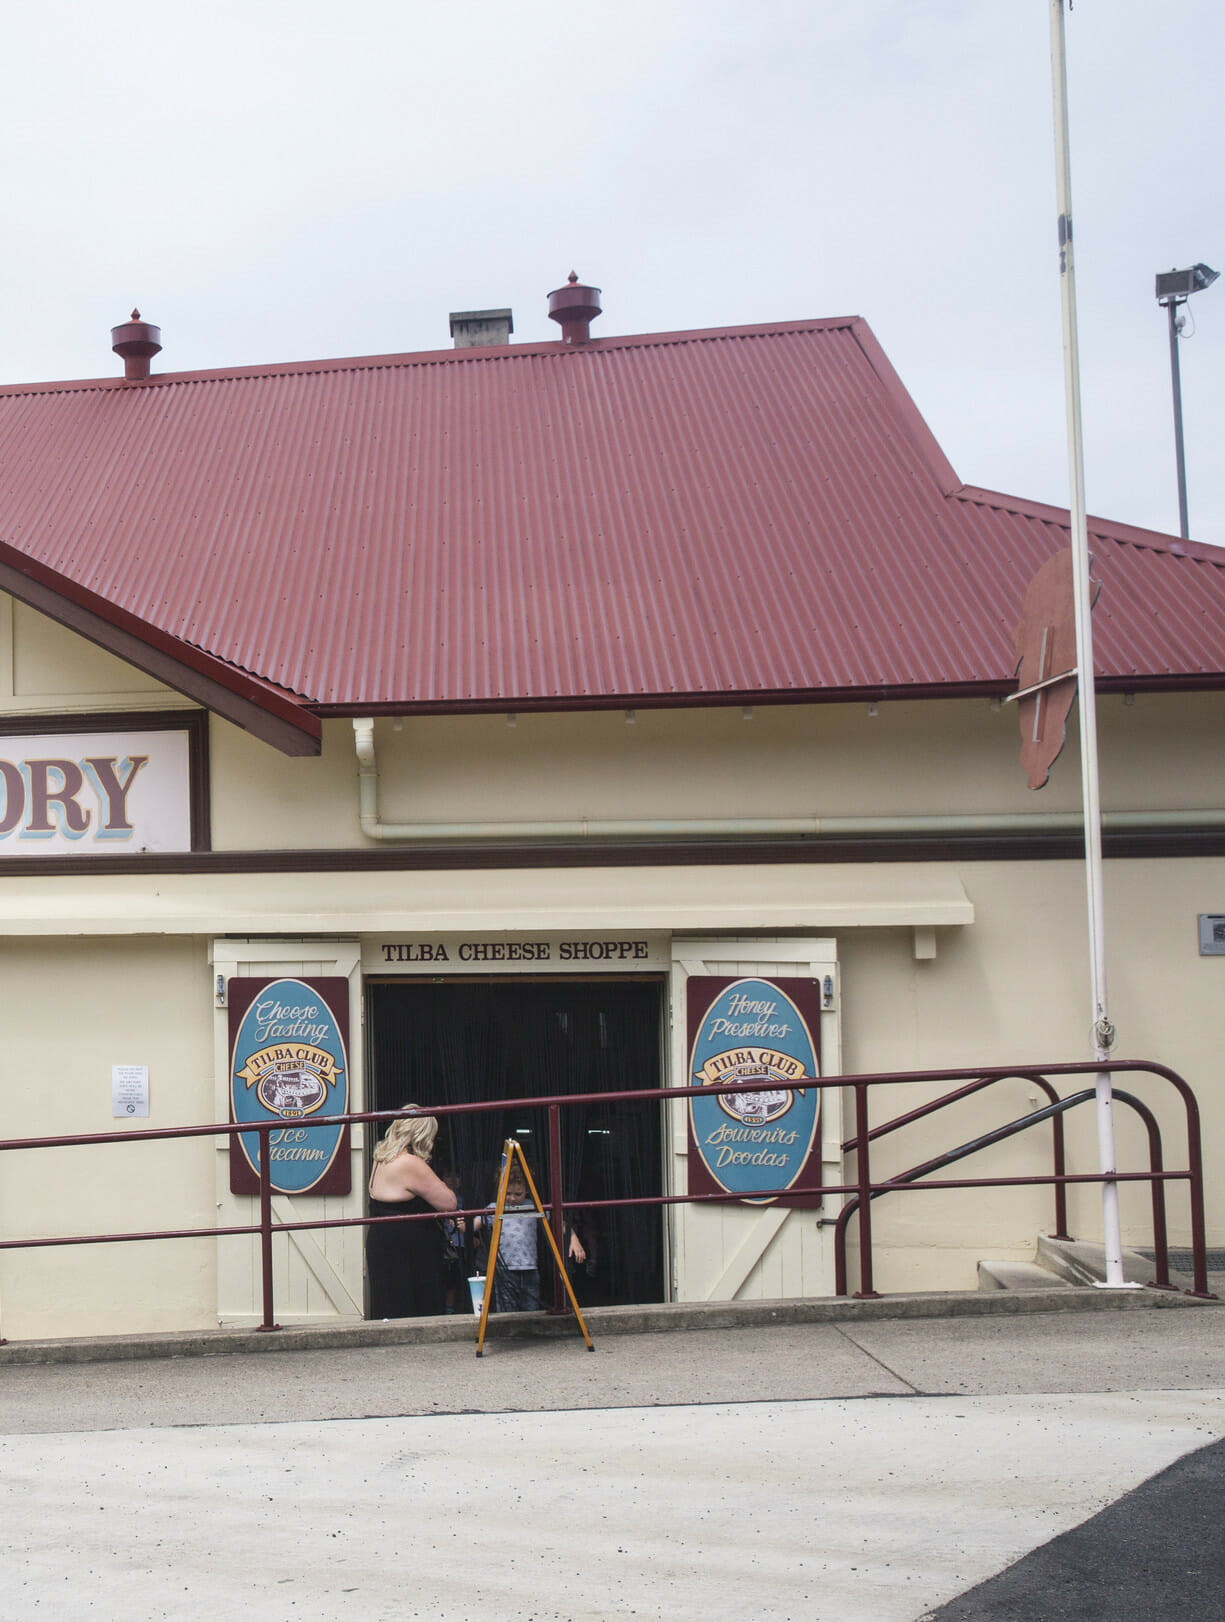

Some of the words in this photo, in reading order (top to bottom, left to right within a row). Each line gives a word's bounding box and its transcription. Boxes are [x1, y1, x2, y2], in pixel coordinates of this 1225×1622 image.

[382, 944, 449, 961] TILBA
[458, 943, 551, 960] CHEESE
[559, 941, 649, 960] SHOPPE
[256, 1000, 320, 1024] Cheese
[728, 994, 778, 1024] Honey
[254, 1019, 328, 1045] Tasting
[708, 1018, 792, 1041] Preserves
[251, 1048, 293, 1068] TILBA
[296, 1048, 329, 1067] CLUB
[276, 1061, 305, 1072] CHEESE
[710, 1050, 756, 1073] TILBA
[759, 1051, 798, 1076] CLUB
[737, 1066, 767, 1076] CHEESE
[705, 1123, 800, 1145] Souvenirs
[257, 1147, 329, 1161] reamm
[716, 1145, 790, 1168] Doodas
